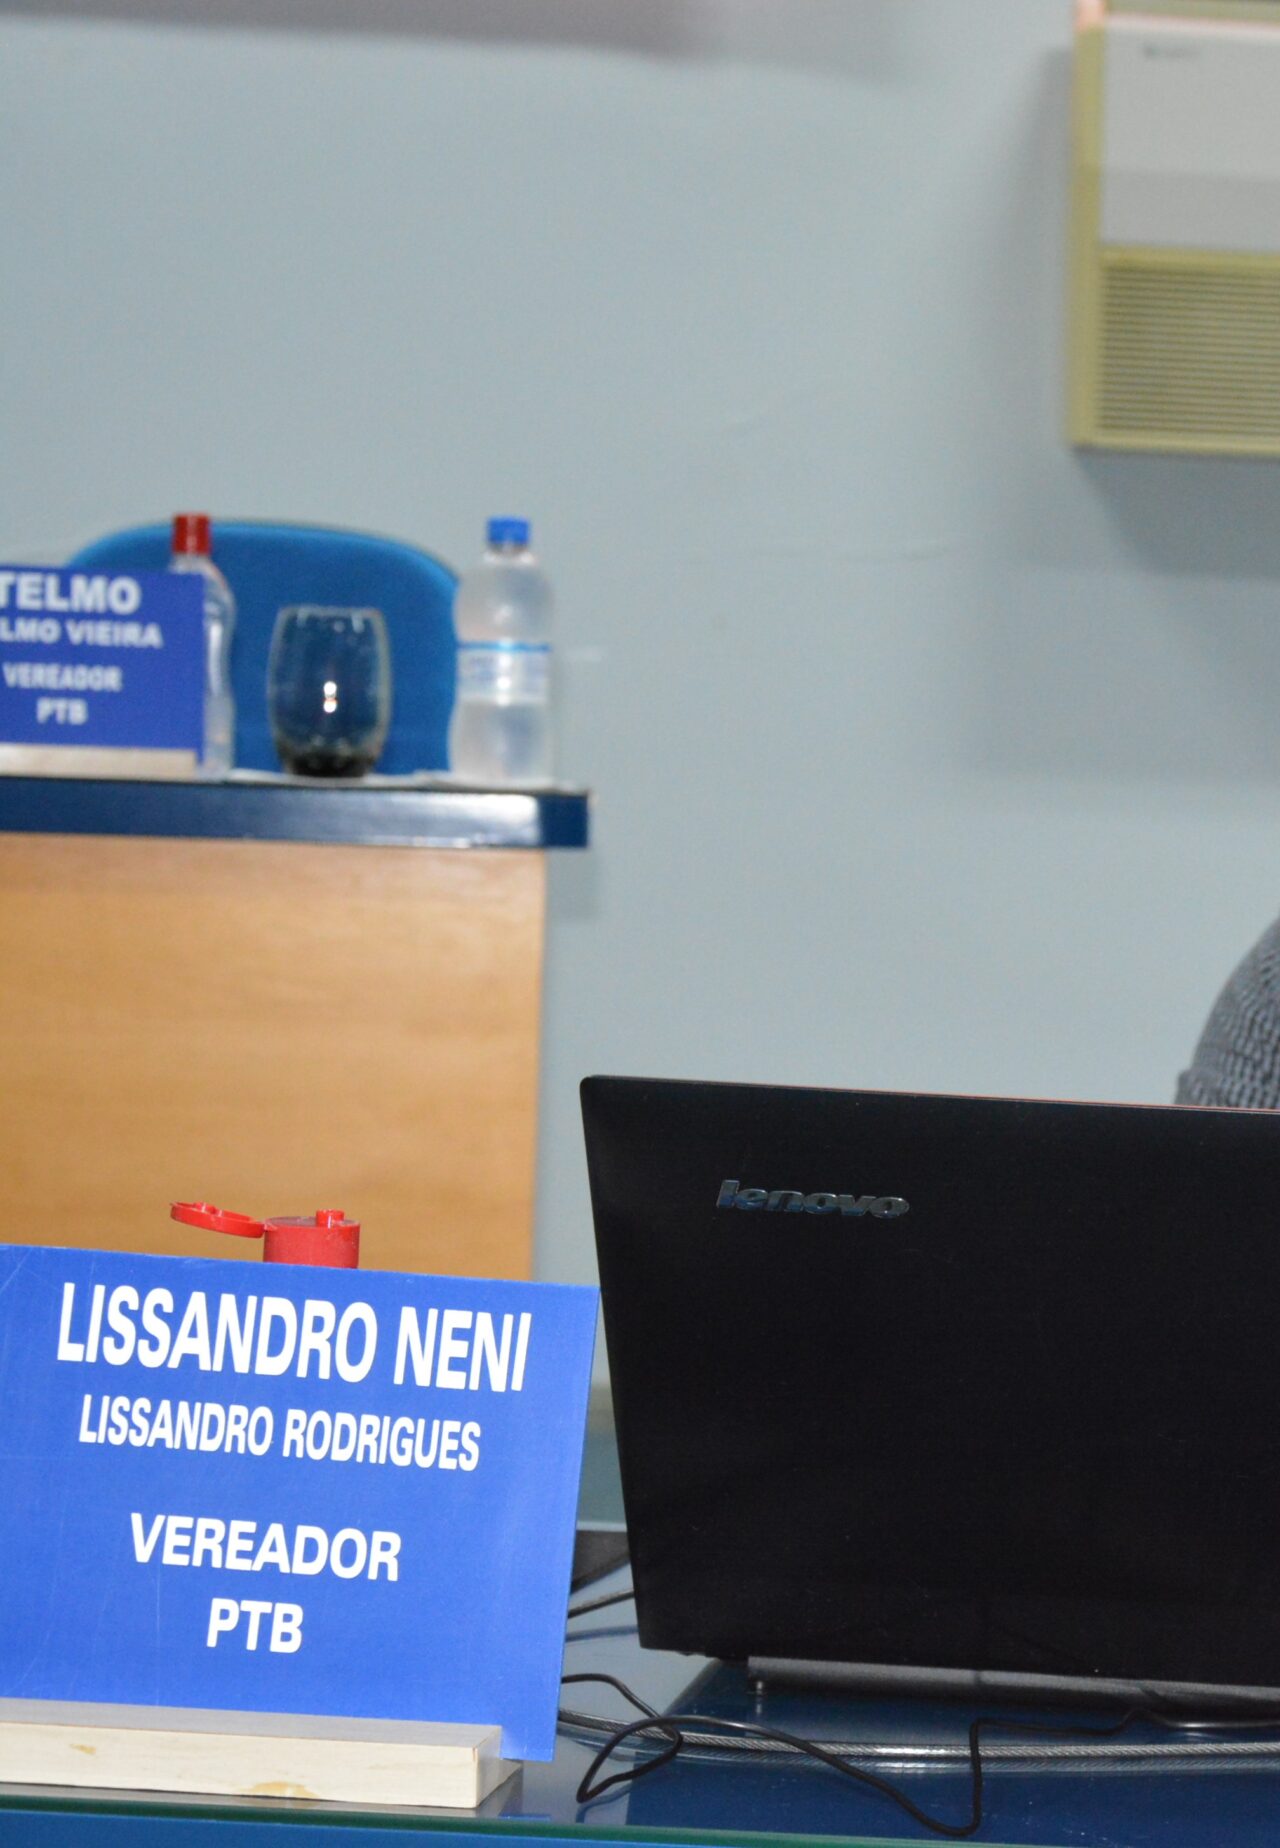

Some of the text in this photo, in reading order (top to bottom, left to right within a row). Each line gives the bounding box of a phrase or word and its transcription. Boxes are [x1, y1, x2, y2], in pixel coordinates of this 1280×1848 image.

[0, 571, 142, 615] TELMO
[65, 619, 163, 648] VIEIRA
[3, 661, 123, 692] VEREADOR
[37, 697, 88, 725] PTB
[716, 1179, 910, 1219] lenovo
[58, 1282, 532, 1393] LISSANDRO NENI
[78, 1394, 481, 1472] LISSANDRO RODRIGUES
[130, 1512, 402, 1582] VEREADOR
[206, 1598, 304, 1654] PTB
